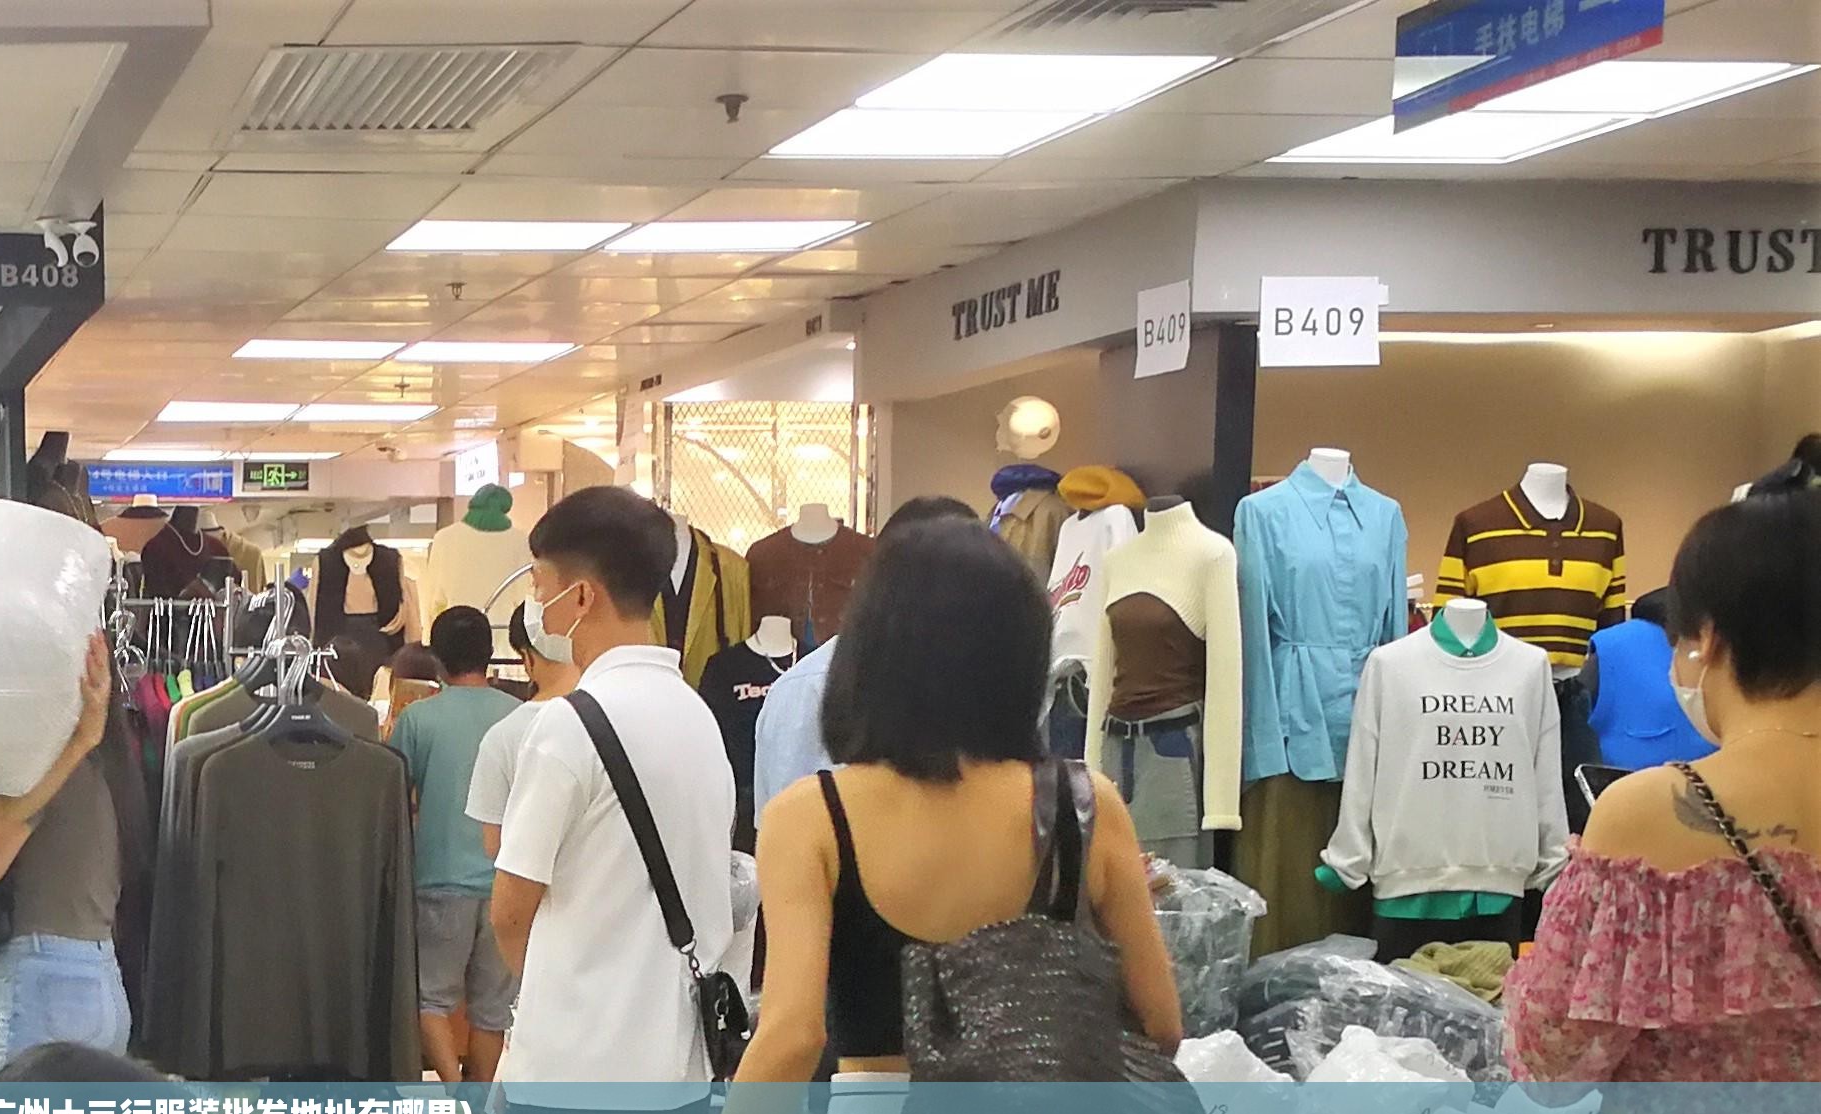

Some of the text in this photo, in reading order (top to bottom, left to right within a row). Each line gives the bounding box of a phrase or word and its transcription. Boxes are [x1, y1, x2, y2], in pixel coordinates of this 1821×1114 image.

[0, 263, 79, 288] B408
[952, 270, 1061, 341] TRUST ME
[1144, 312, 1186, 348] B409
[1275, 308, 1364, 336] B409
[1420, 695, 1515, 716] DREAM
[1436, 725, 1505, 747] BABY
[1422, 760, 1515, 782] DREAM
